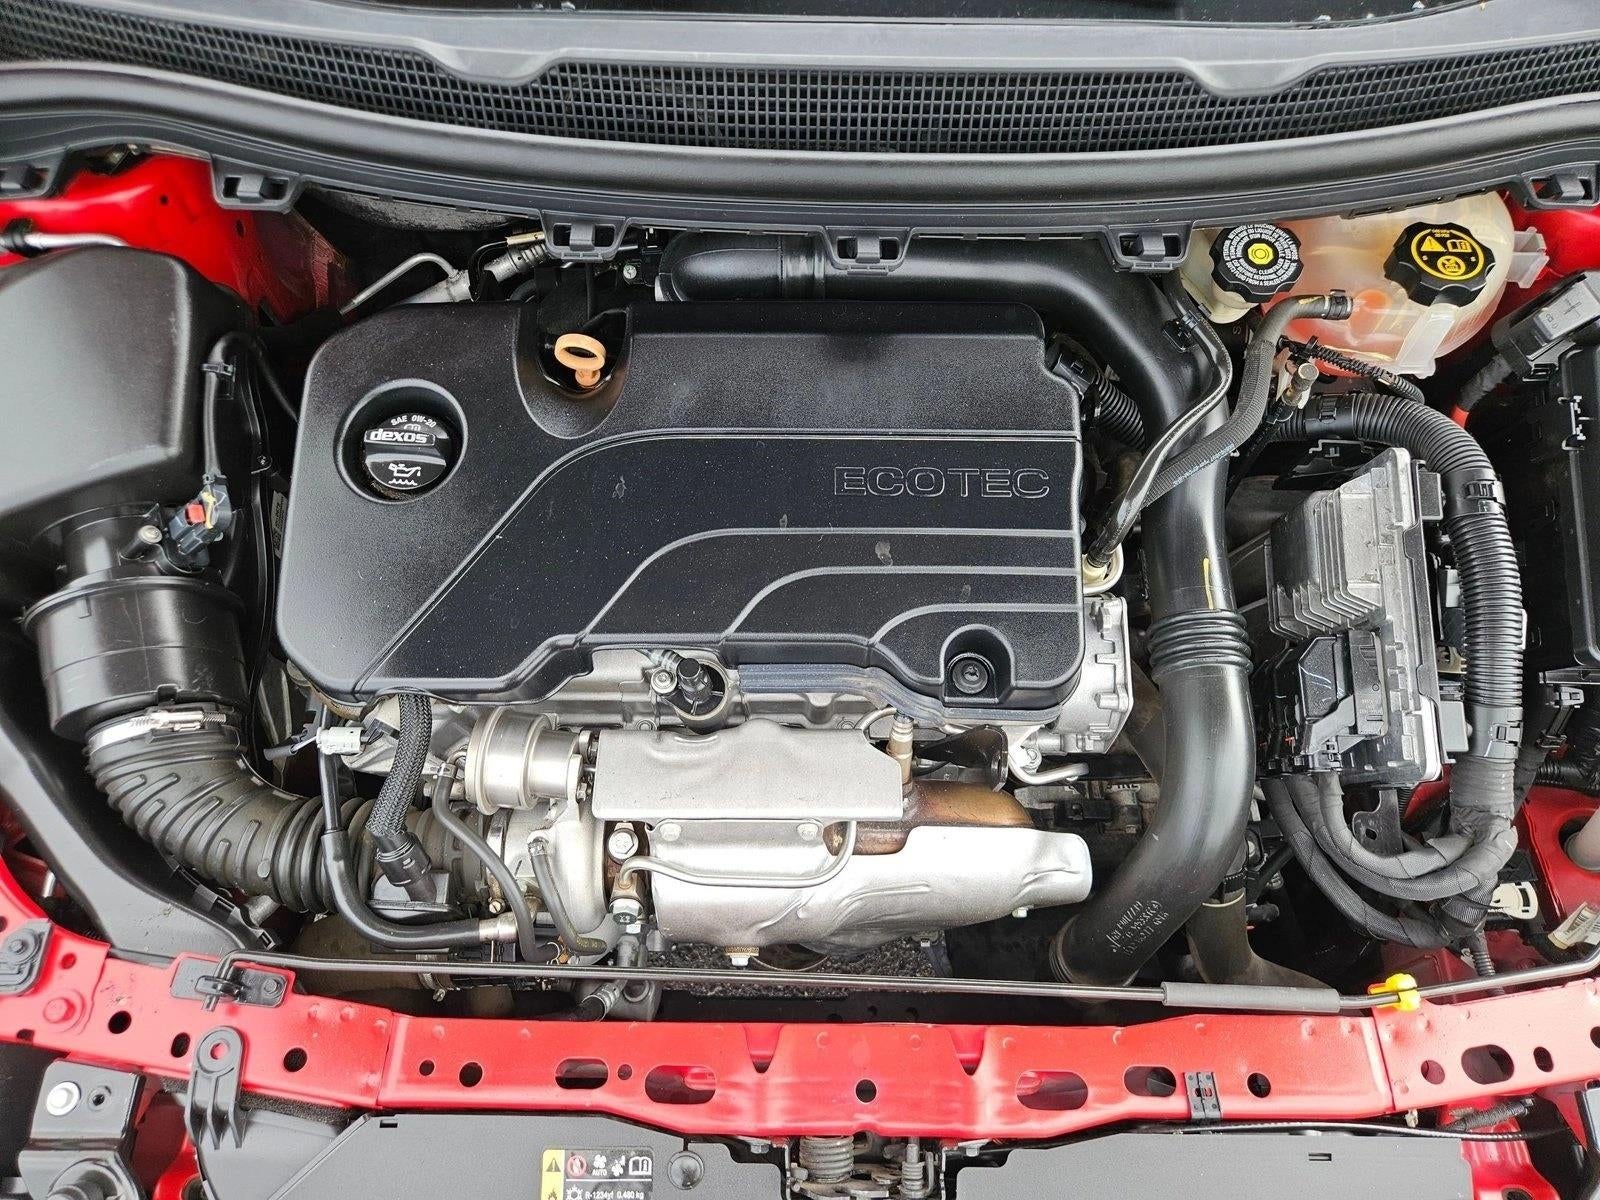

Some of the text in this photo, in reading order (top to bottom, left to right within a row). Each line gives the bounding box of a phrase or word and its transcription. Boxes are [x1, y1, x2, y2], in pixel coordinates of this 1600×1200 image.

[391, 415, 408, 426] SAE
[370, 428, 428, 443] dexos
[834, 466, 1050, 499] ECOTEC
